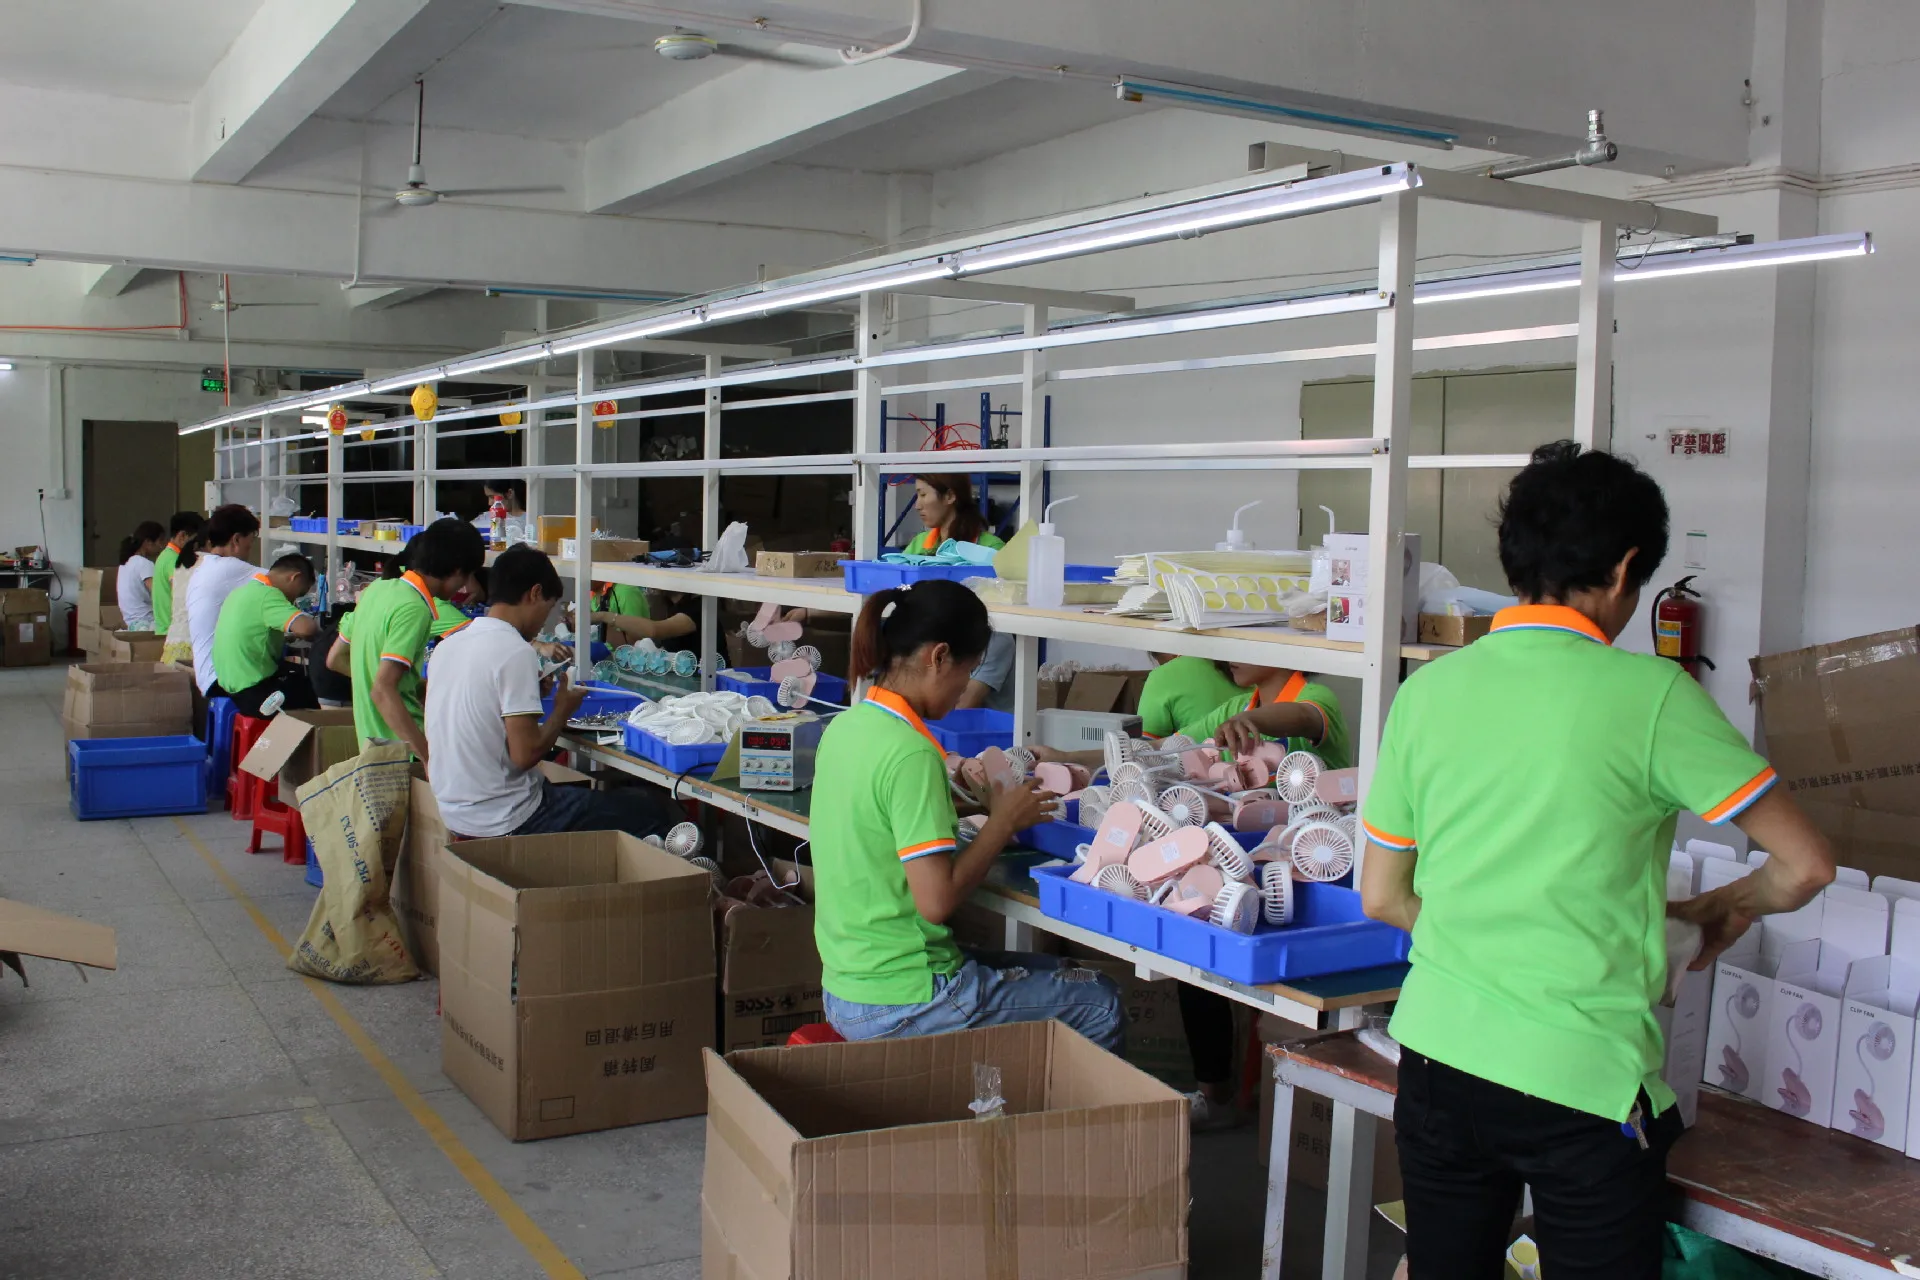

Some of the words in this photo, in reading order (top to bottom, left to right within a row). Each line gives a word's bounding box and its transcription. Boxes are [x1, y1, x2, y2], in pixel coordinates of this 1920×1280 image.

[1850, 1006, 1863, 1015] CLIP
[1863, 1010, 1875, 1018] FAN
[585, 1018, 676, 1047] 用后请退回
[602, 1054, 657, 1080] 周转箱
